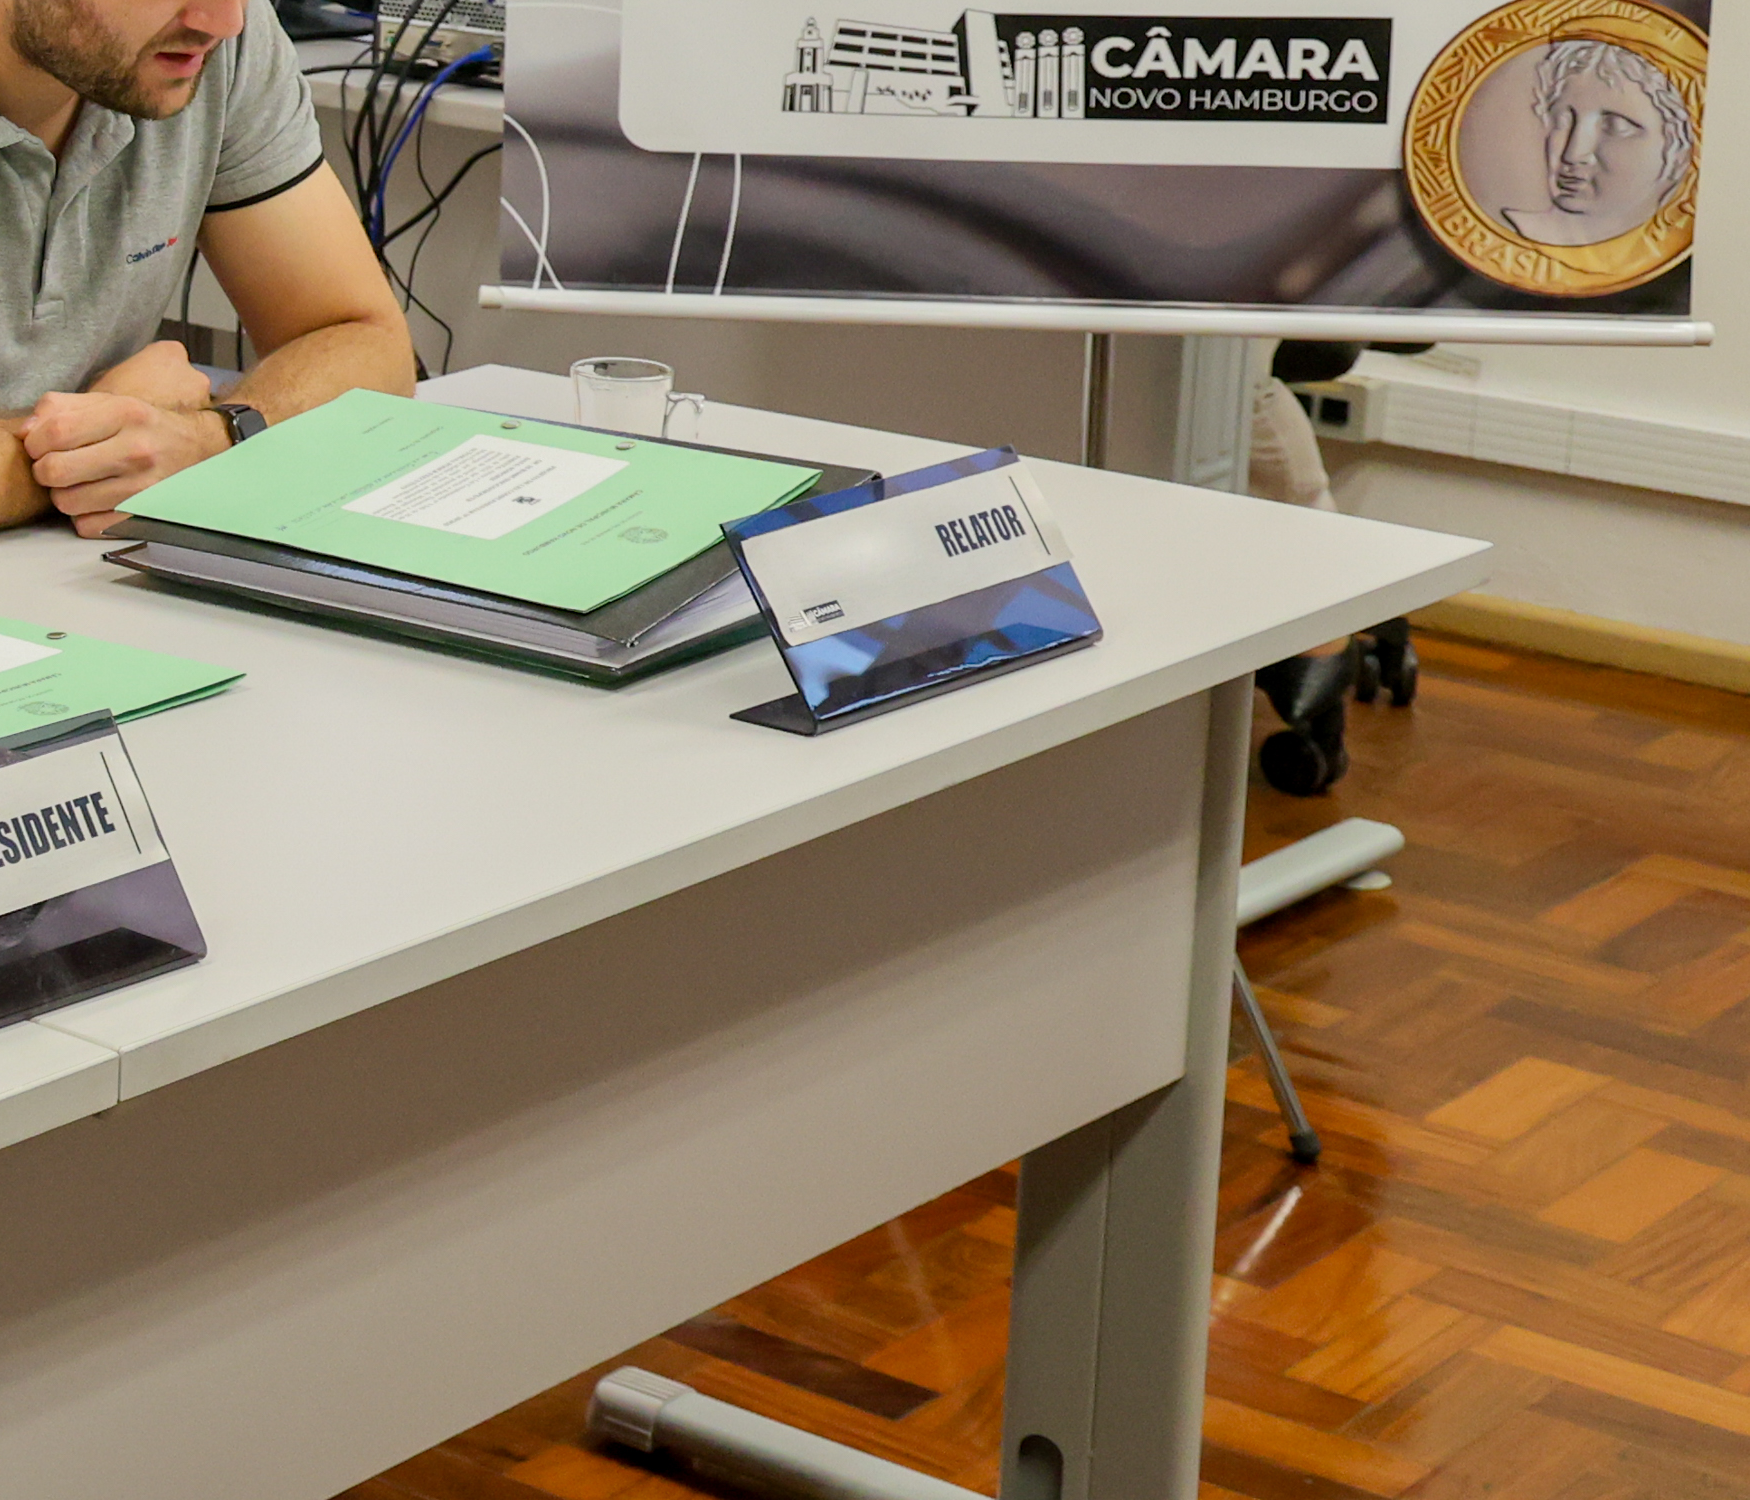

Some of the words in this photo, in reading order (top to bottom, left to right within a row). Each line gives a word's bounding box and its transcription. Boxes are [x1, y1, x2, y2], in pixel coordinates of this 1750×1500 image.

[1091, 26, 1380, 81] CÂMARA
[1089, 87, 1181, 109] NOVO
[1189, 89, 1379, 112] HAMBURGO
[934, 505, 1026, 557] RELATOR
